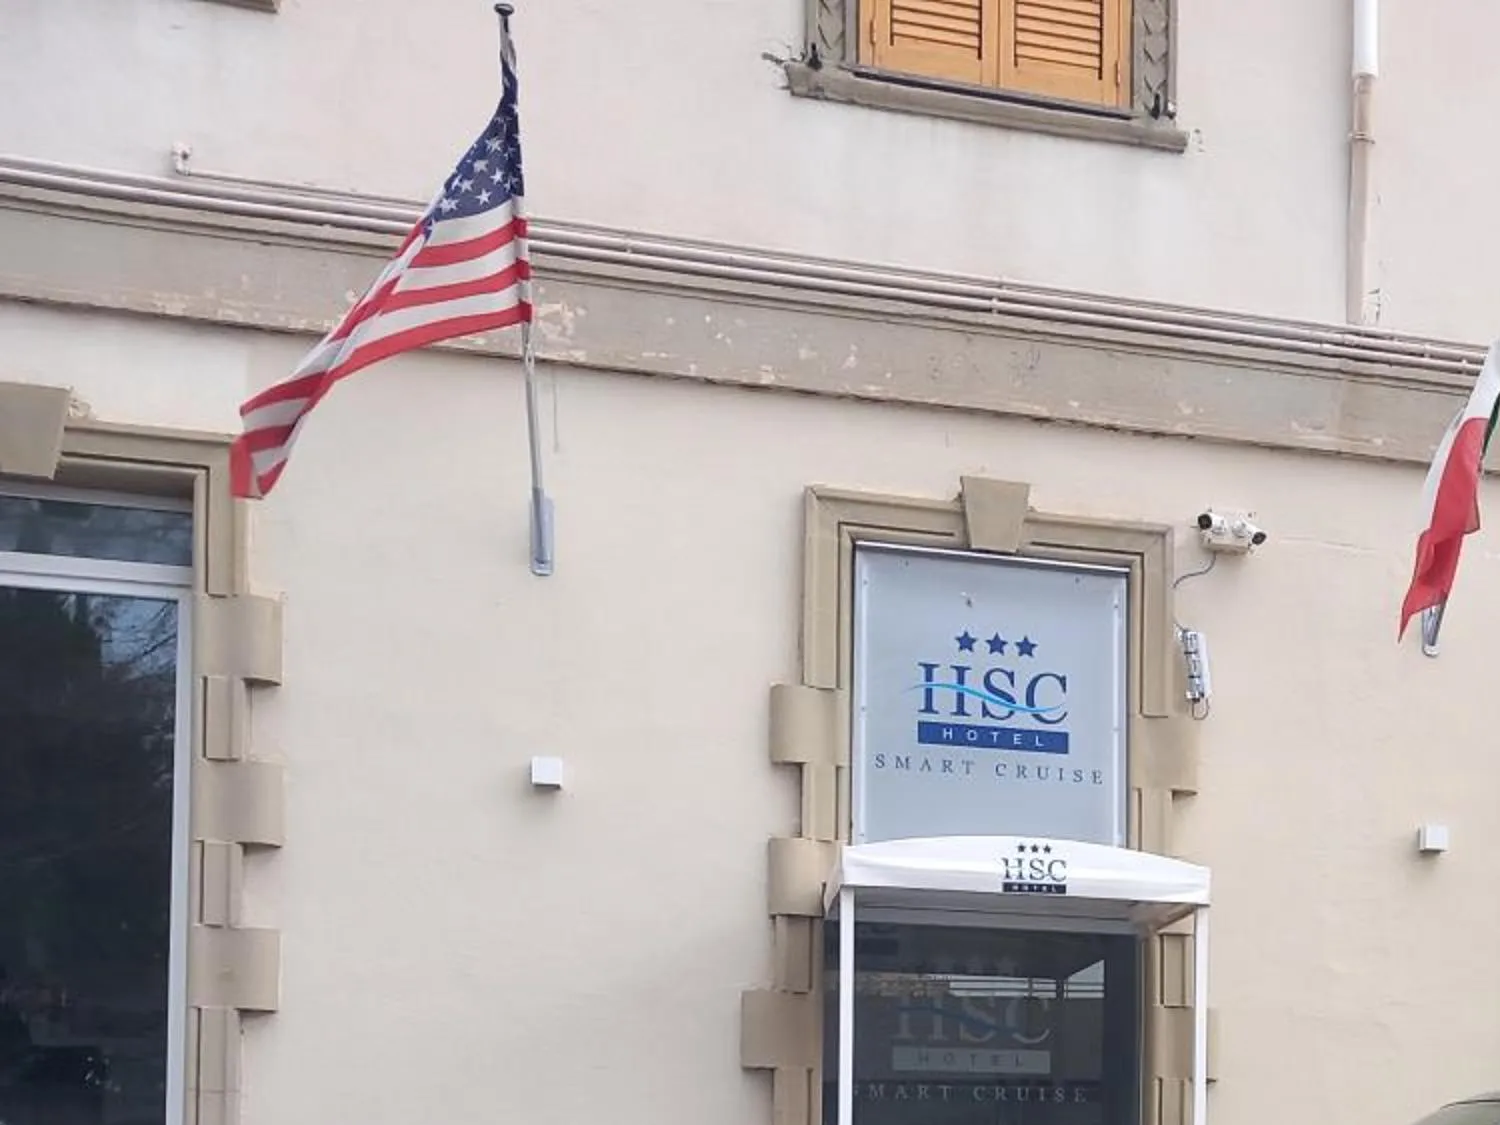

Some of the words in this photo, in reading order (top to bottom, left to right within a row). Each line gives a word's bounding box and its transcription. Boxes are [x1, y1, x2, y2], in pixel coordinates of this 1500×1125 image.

[917, 661, 1068, 725] HSC
[942, 728, 1044, 747] HOTEL
[874, 753, 975, 775] SMART
[995, 763, 1103, 785] CRUISE
[1001, 857, 1067, 882] HSC
[917, 1053, 1024, 1067] HOTEL
[972, 1086, 1087, 1102] CRUISE
